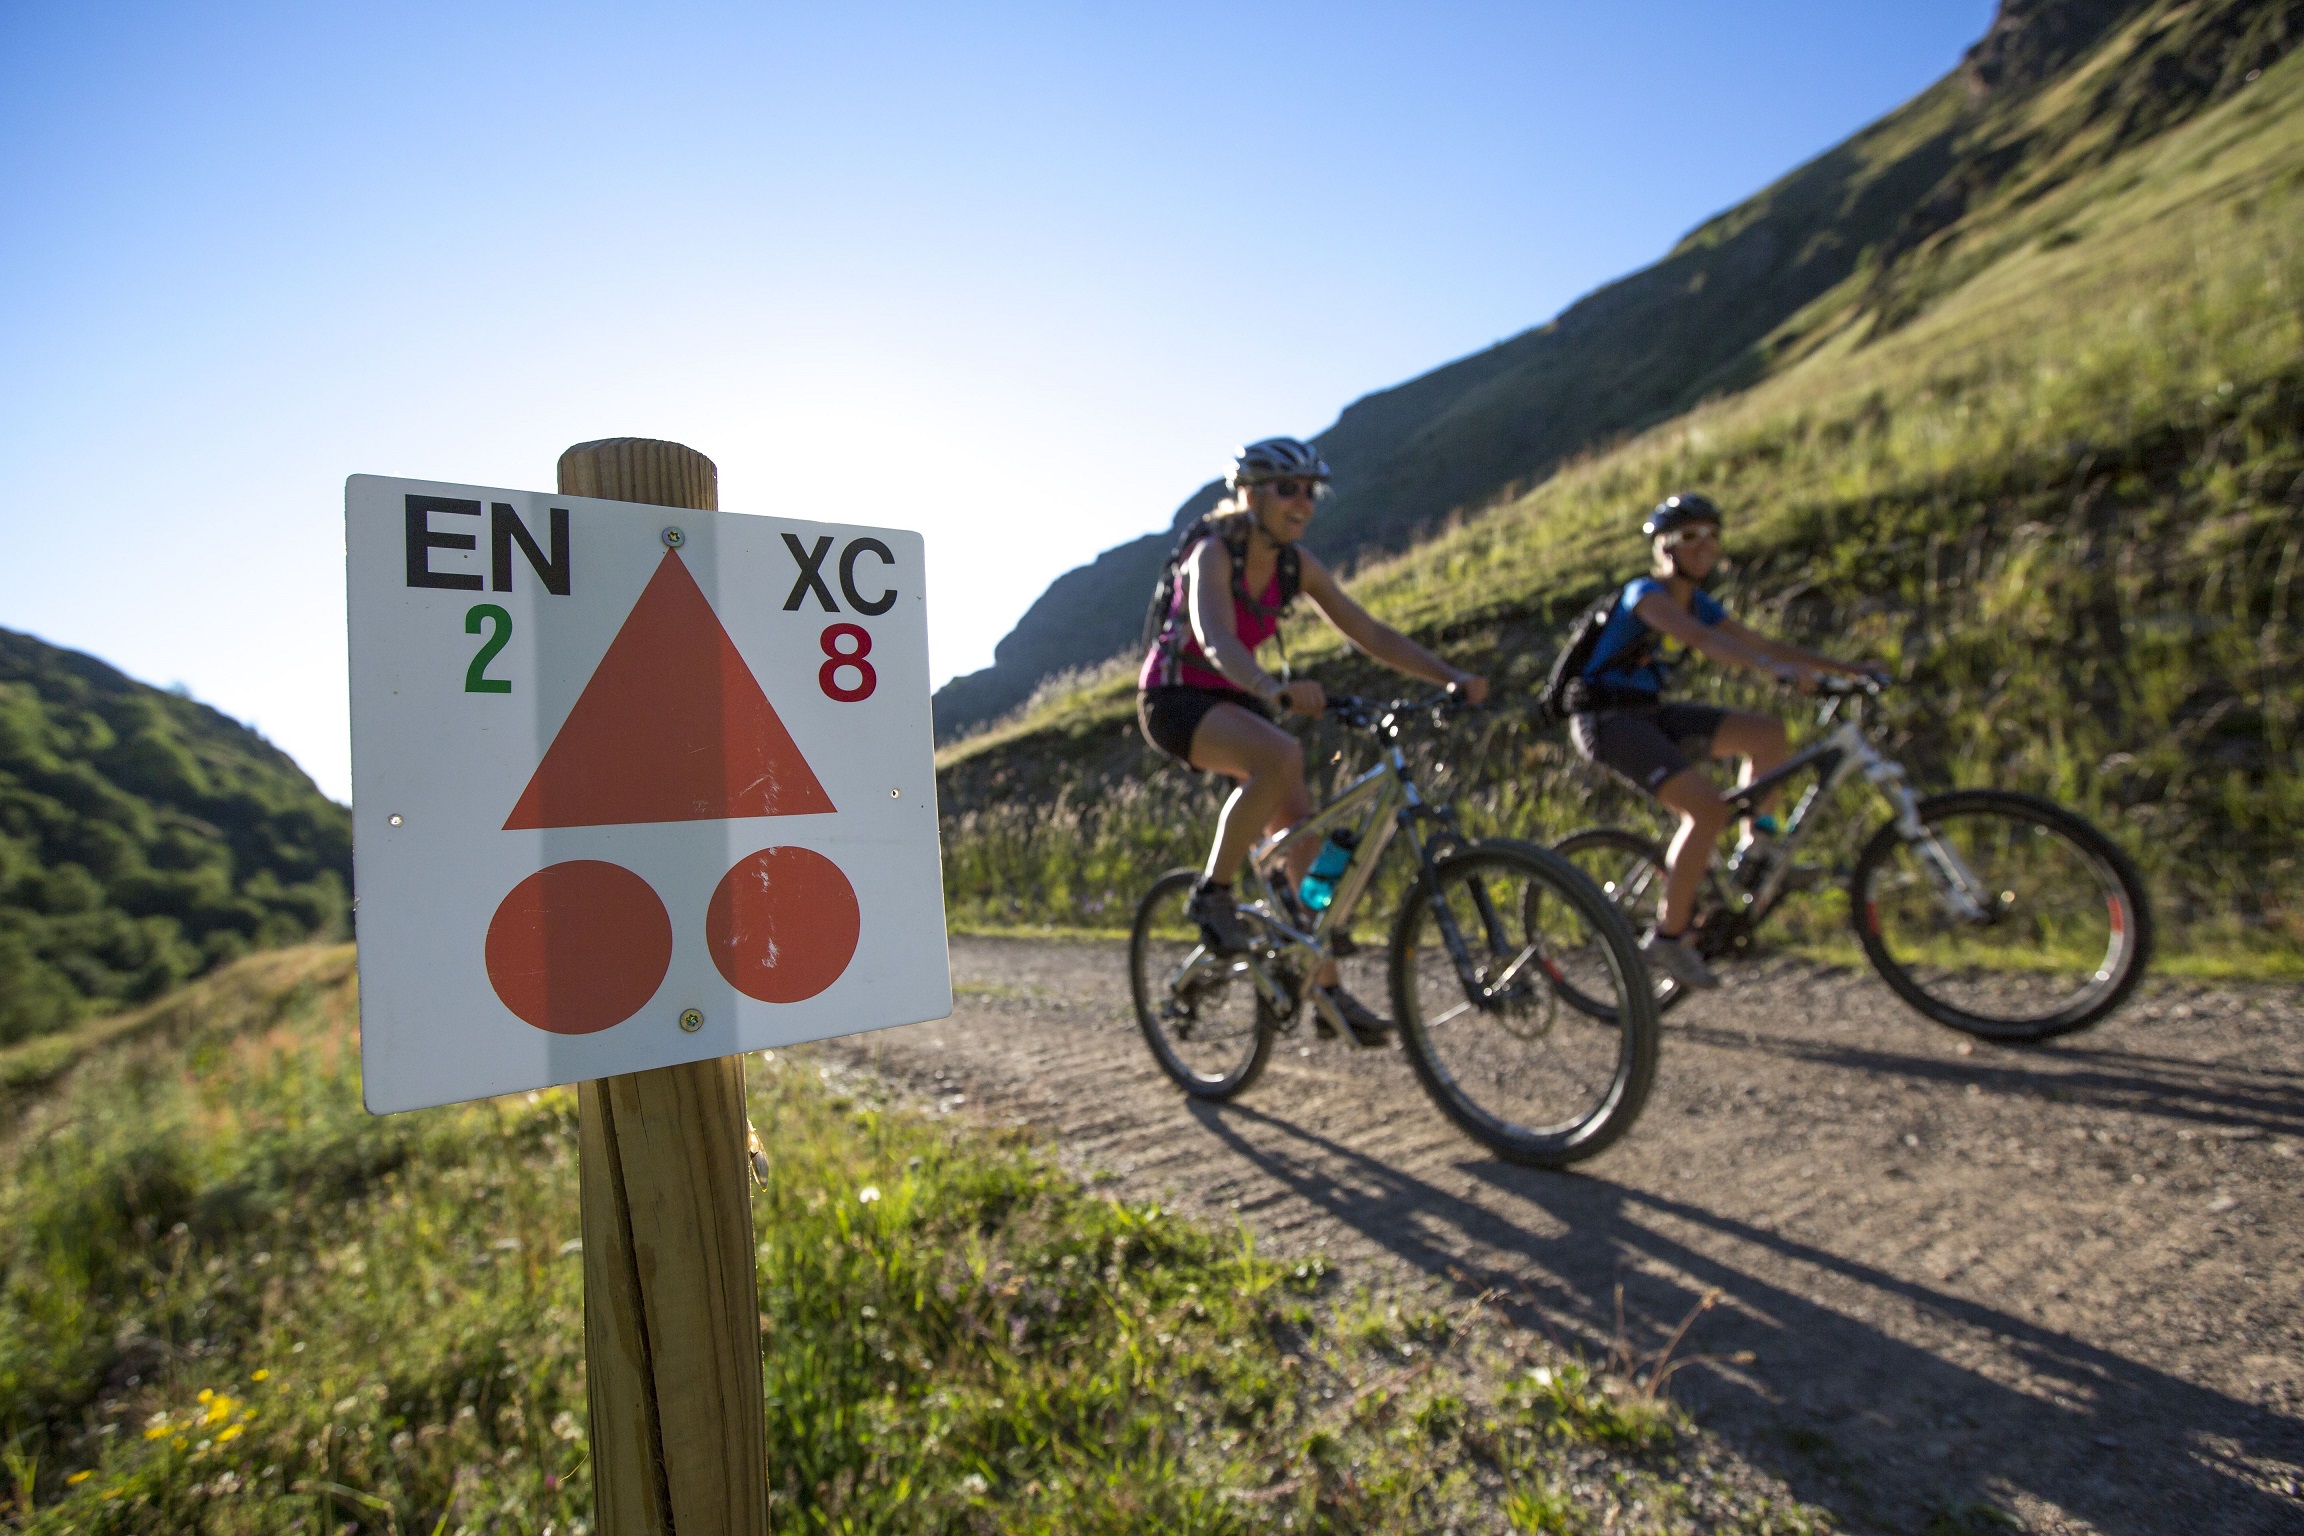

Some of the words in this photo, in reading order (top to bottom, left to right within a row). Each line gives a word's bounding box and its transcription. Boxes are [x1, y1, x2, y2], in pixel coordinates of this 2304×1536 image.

[405, 494, 571, 596] EN
[781, 533, 898, 617] XC
[464, 604, 513, 694] 2
[818, 623, 877, 703] 8
